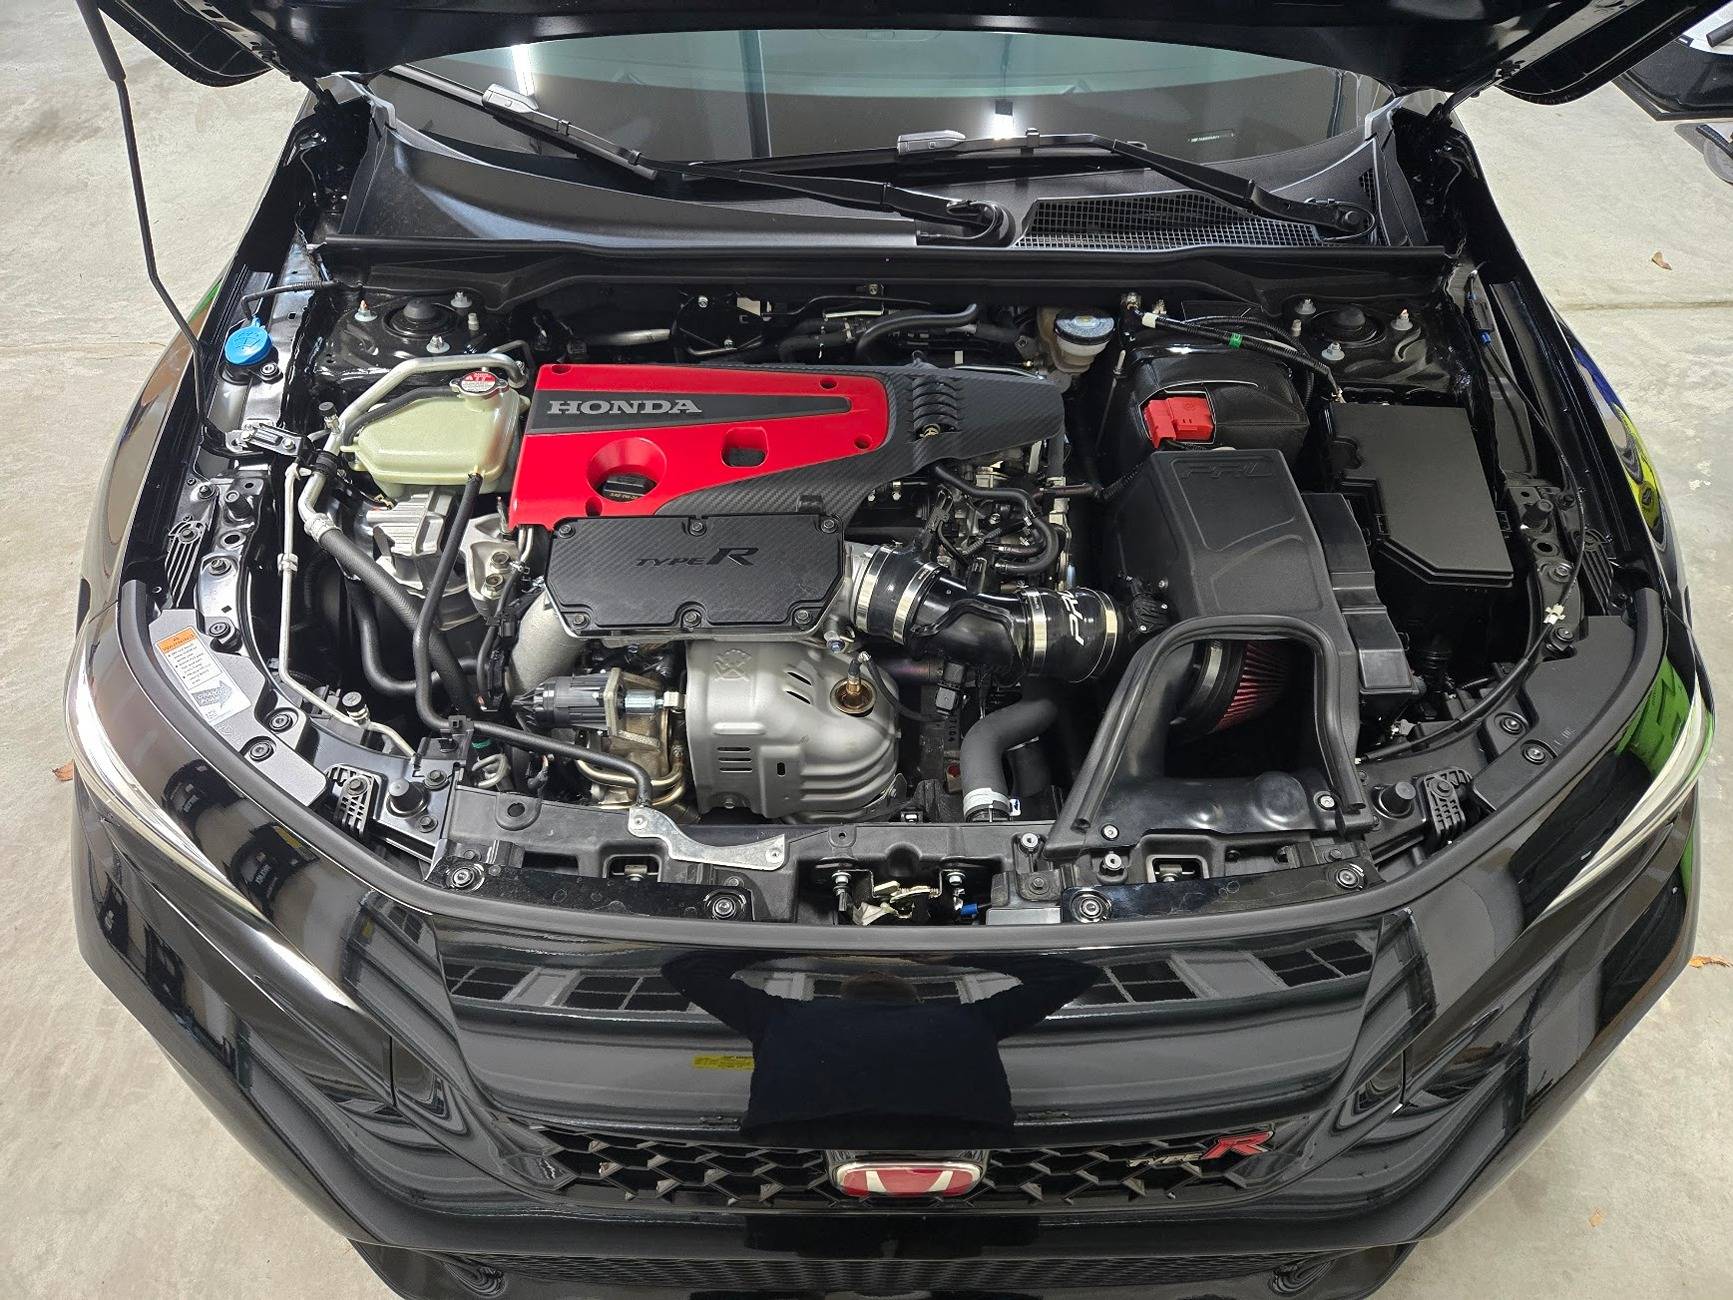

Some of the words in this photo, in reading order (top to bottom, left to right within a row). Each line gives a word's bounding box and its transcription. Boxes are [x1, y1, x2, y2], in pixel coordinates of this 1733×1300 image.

[547, 399, 702, 415] HONDA
[636, 557, 706, 568] TYPE
[706, 547, 760, 567] R
[1201, 1130, 1274, 1160] R
